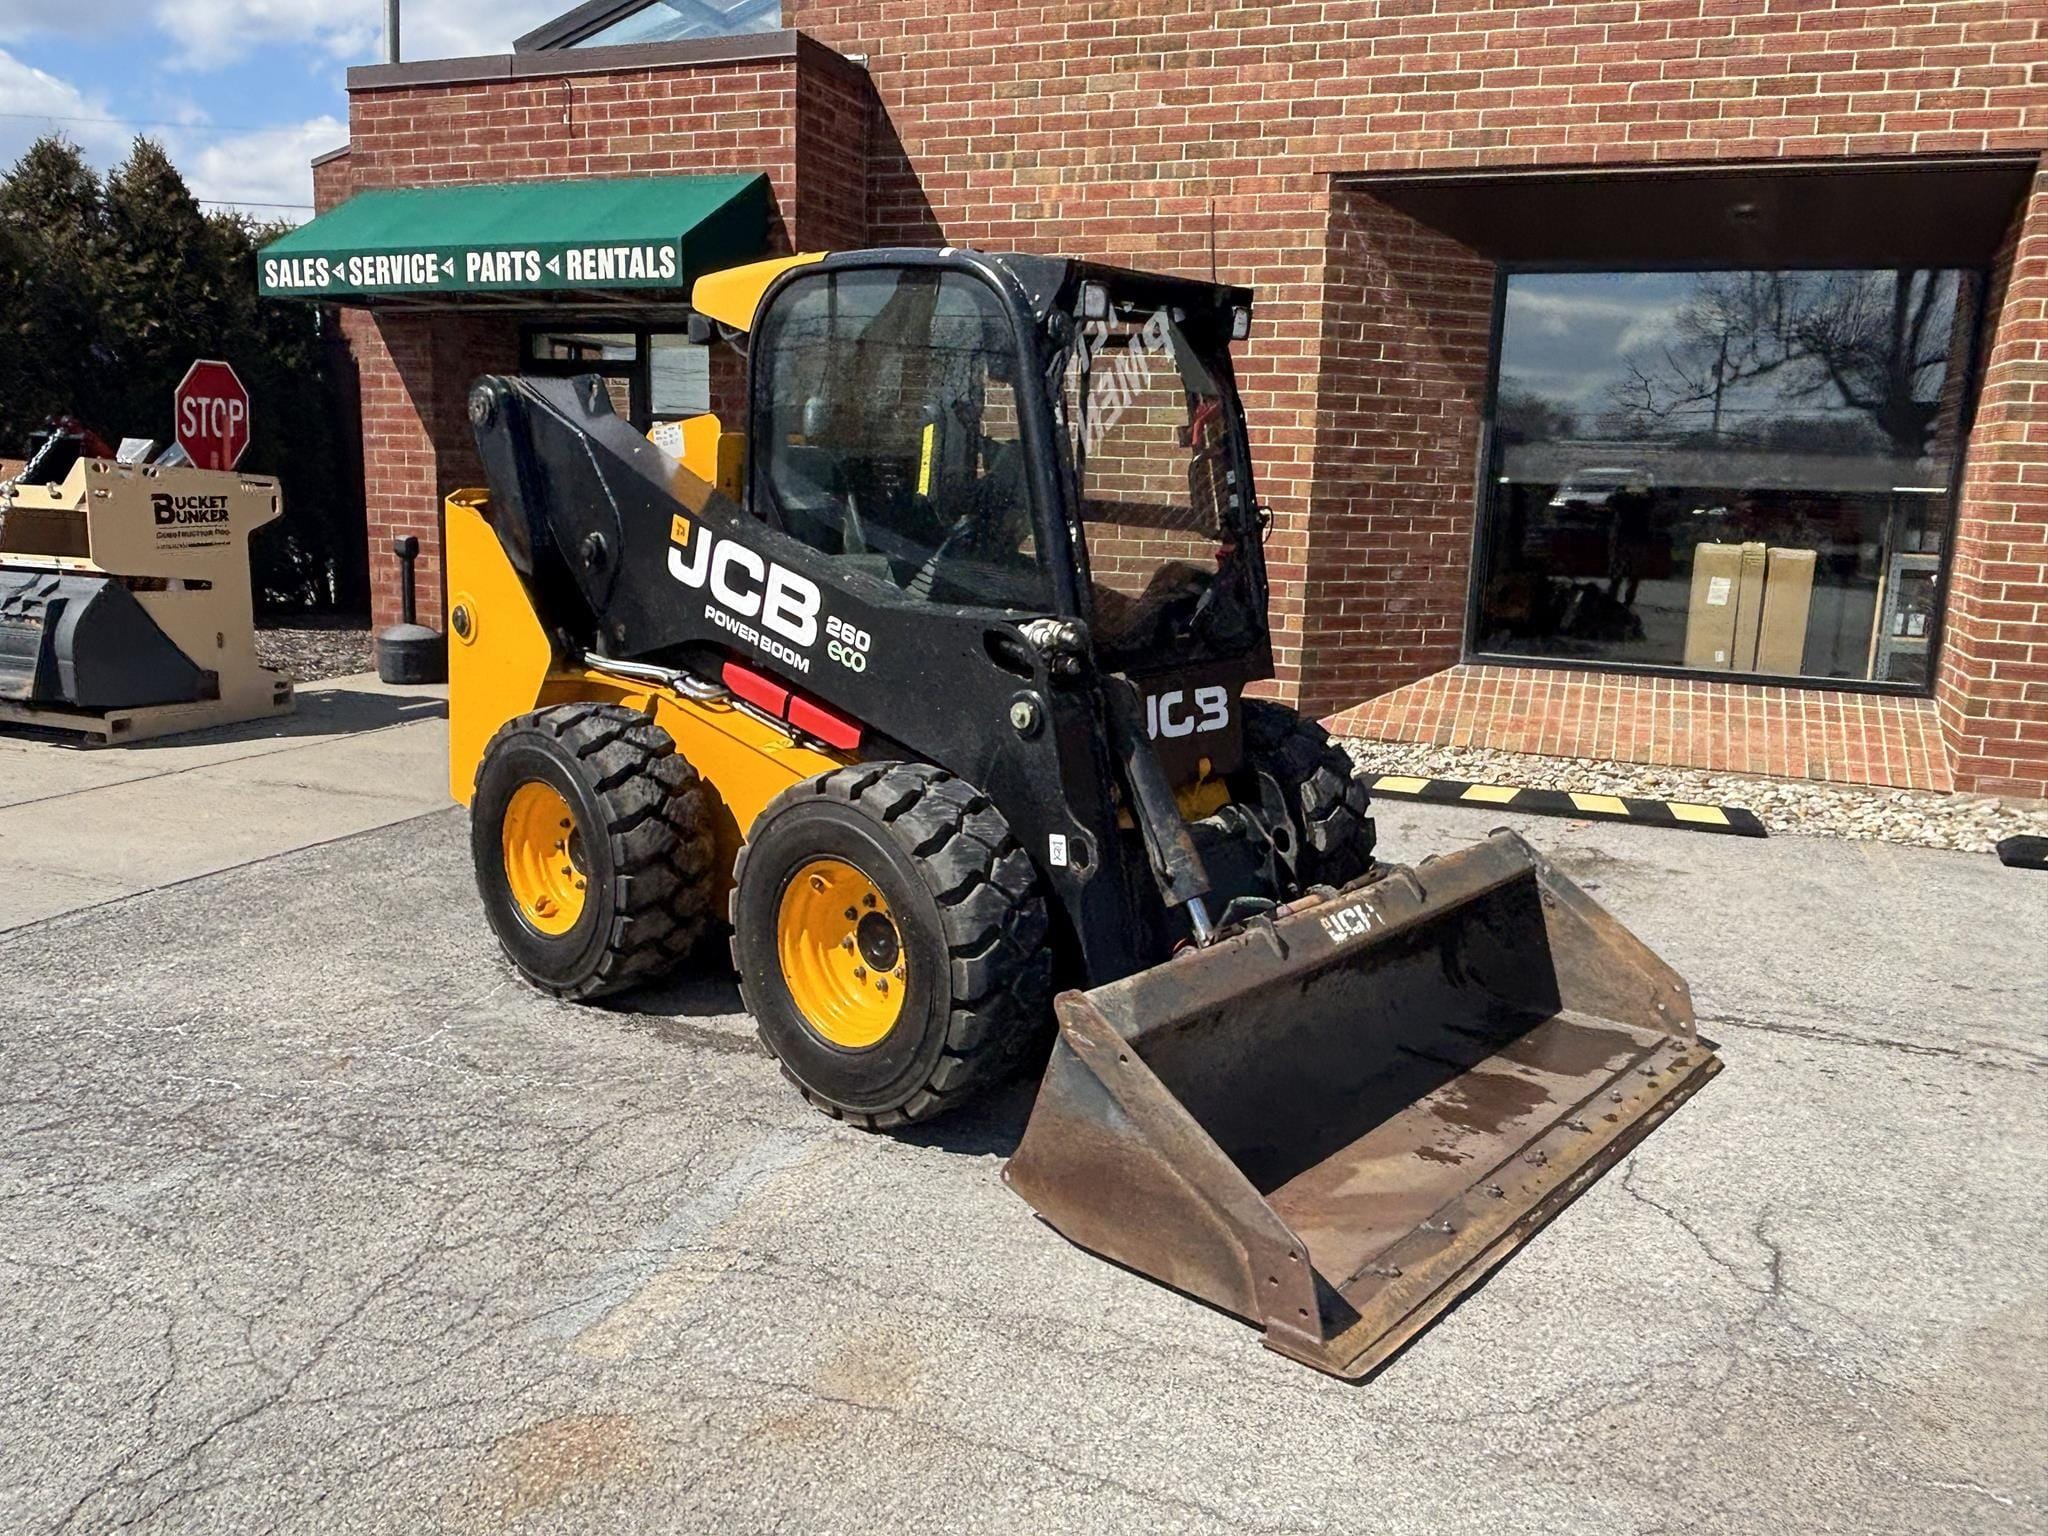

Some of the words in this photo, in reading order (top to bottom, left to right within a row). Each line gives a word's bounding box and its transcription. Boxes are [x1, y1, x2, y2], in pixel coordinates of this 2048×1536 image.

[264, 257, 330, 288] SALES
[348, 253, 440, 286] SERVICE
[466, 250, 541, 283] PARTS
[566, 246, 676, 281] RENTALS
[181, 396, 244, 438] STOP
[667, 526, 821, 647] JCB
[825, 615, 871, 652] 260
[827, 640, 866, 673] eco
